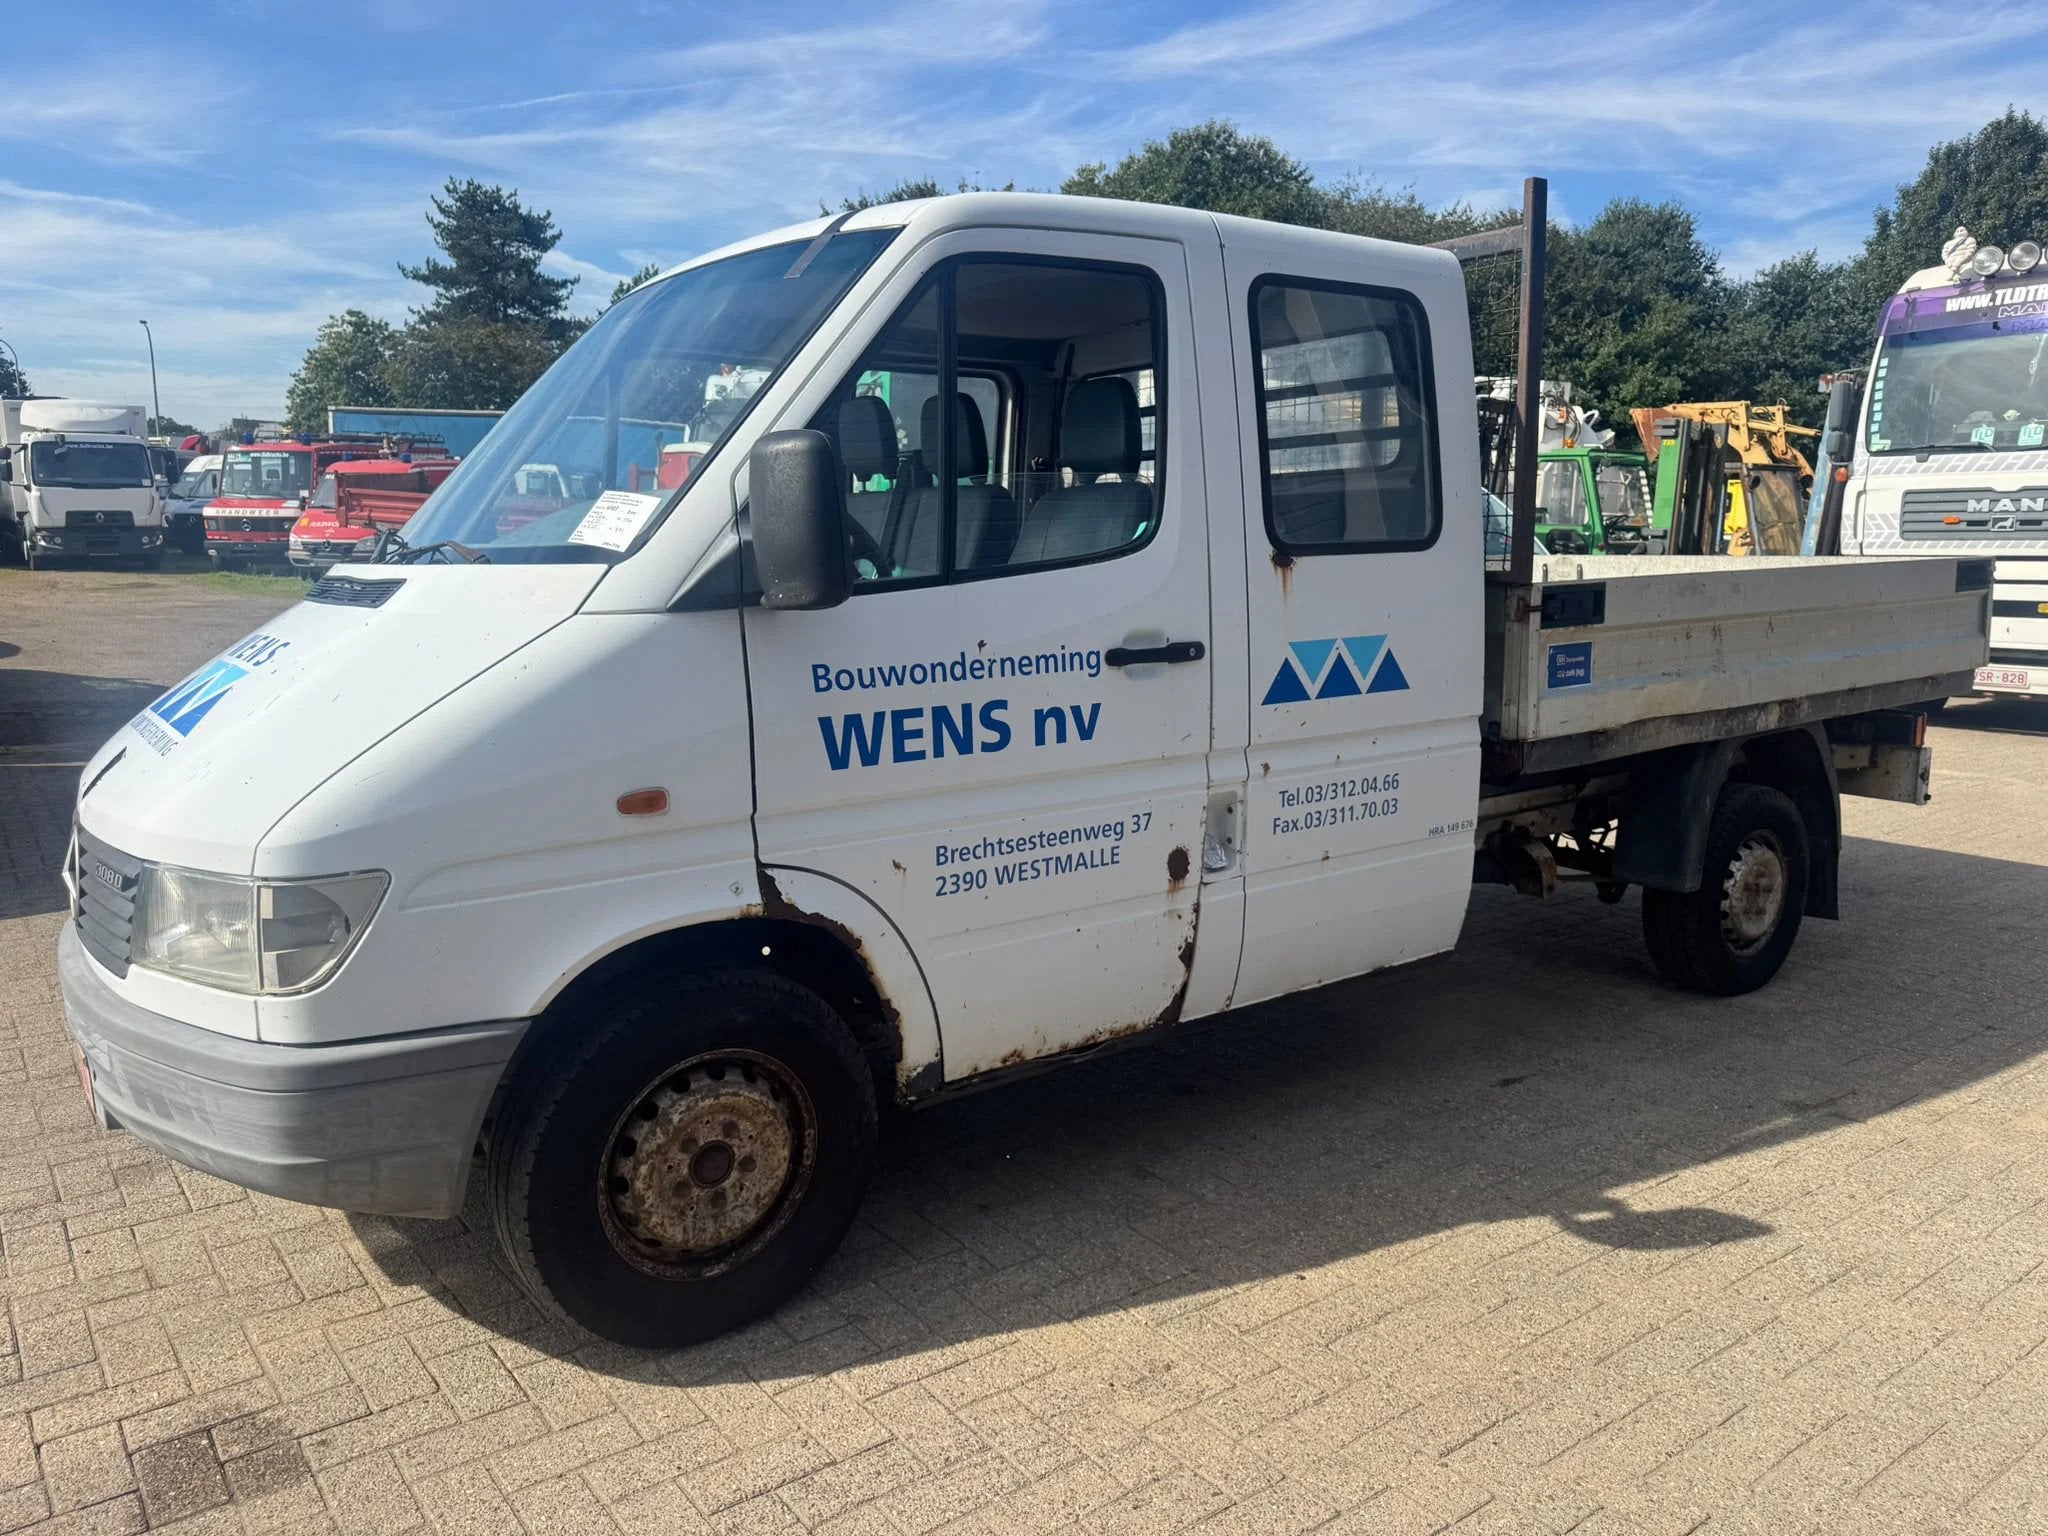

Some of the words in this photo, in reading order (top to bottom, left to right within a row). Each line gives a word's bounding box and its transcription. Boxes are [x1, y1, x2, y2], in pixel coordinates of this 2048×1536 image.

[1967, 498, 2045, 513] MAN
[227, 633, 291, 667] WENS
[811, 645, 1101, 693] Bouwonderneming
[817, 699, 1012, 771] WENS
[1033, 702, 1102, 747] nv
[1278, 773, 1400, 808] Tel.03/312.04.66
[1272, 798, 1399, 835] Fax.03/311.70.03
[1428, 825, 1445, 837] HRA
[935, 820, 1125, 867] Brechtsesteenweg
[1131, 812, 1153, 833] 37
[935, 869, 988, 897] 2390
[994, 845, 1121, 885] WESTMALLE
